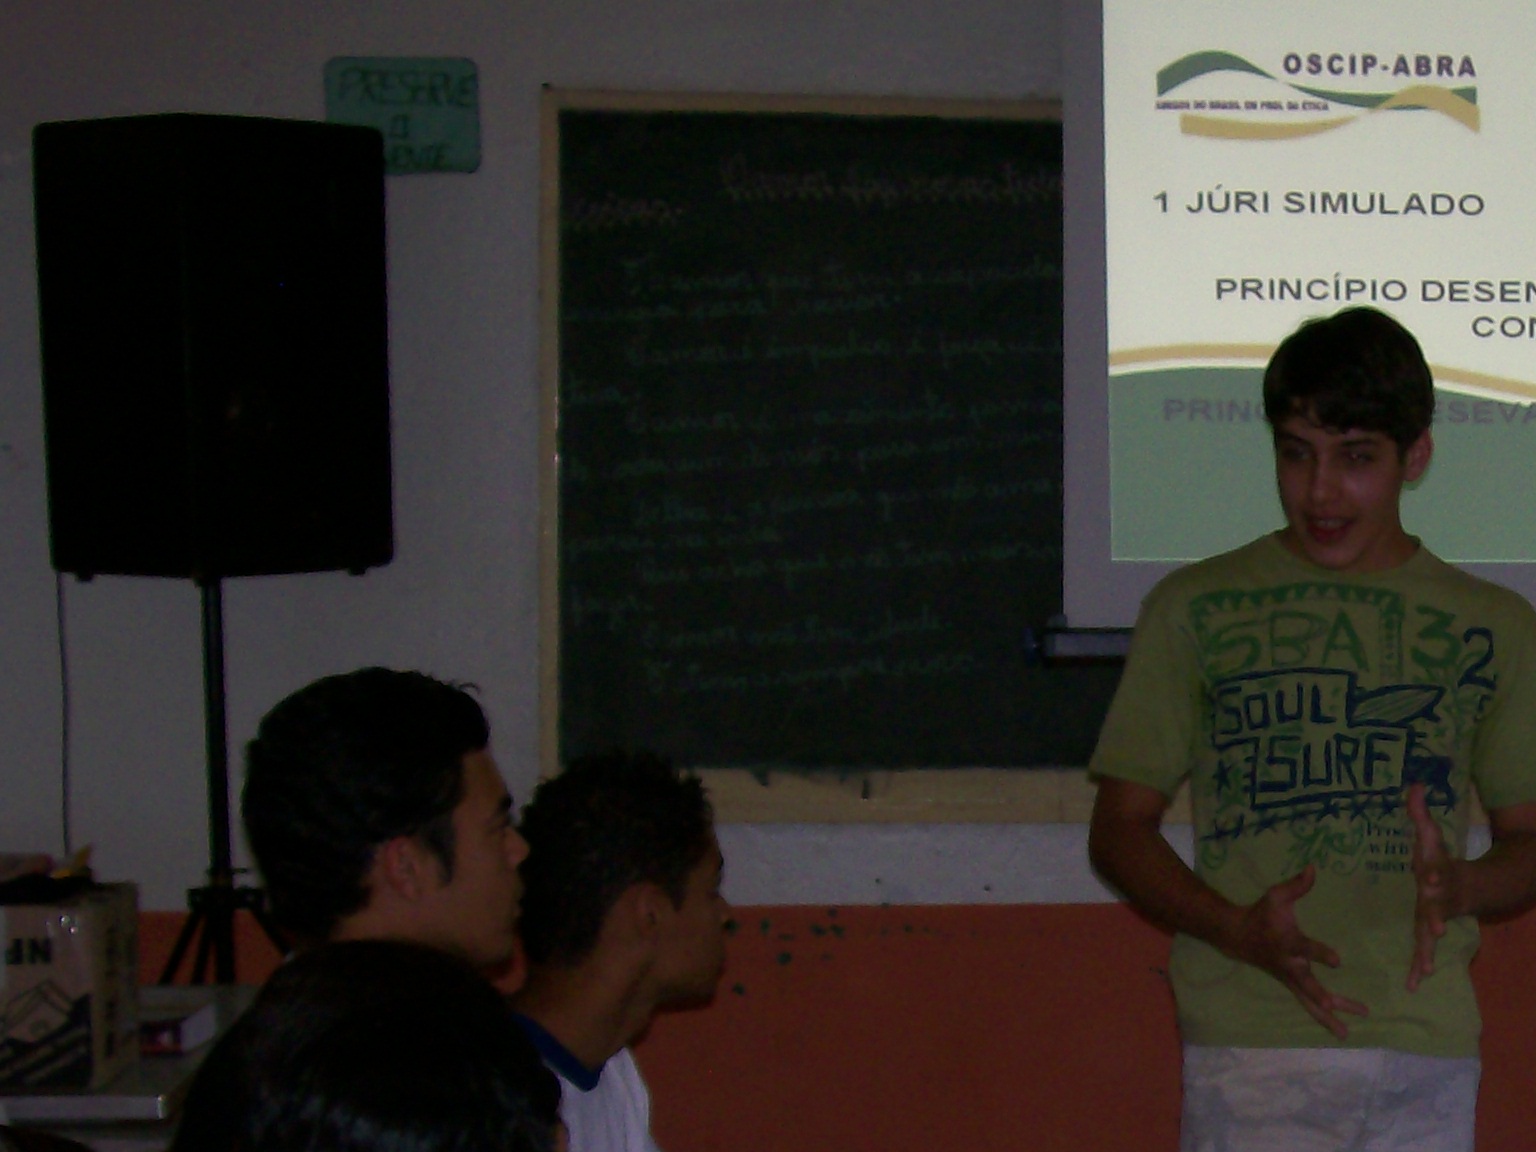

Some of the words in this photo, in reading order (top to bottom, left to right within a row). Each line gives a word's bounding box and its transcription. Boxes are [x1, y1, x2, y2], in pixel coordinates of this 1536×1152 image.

[1283, 53, 1476, 77] OSCIP-ABRA
[1154, 191, 1168, 213] 1
[1186, 184, 1269, 214] JÚRI
[1284, 191, 1485, 216] SIMULADO
[1216, 273, 1408, 302] PRINCÍPIO
[1163, 399, 1264, 421] PRIN
[1216, 684, 1337, 735] SOUL
[1261, 732, 1402, 792] SURF
